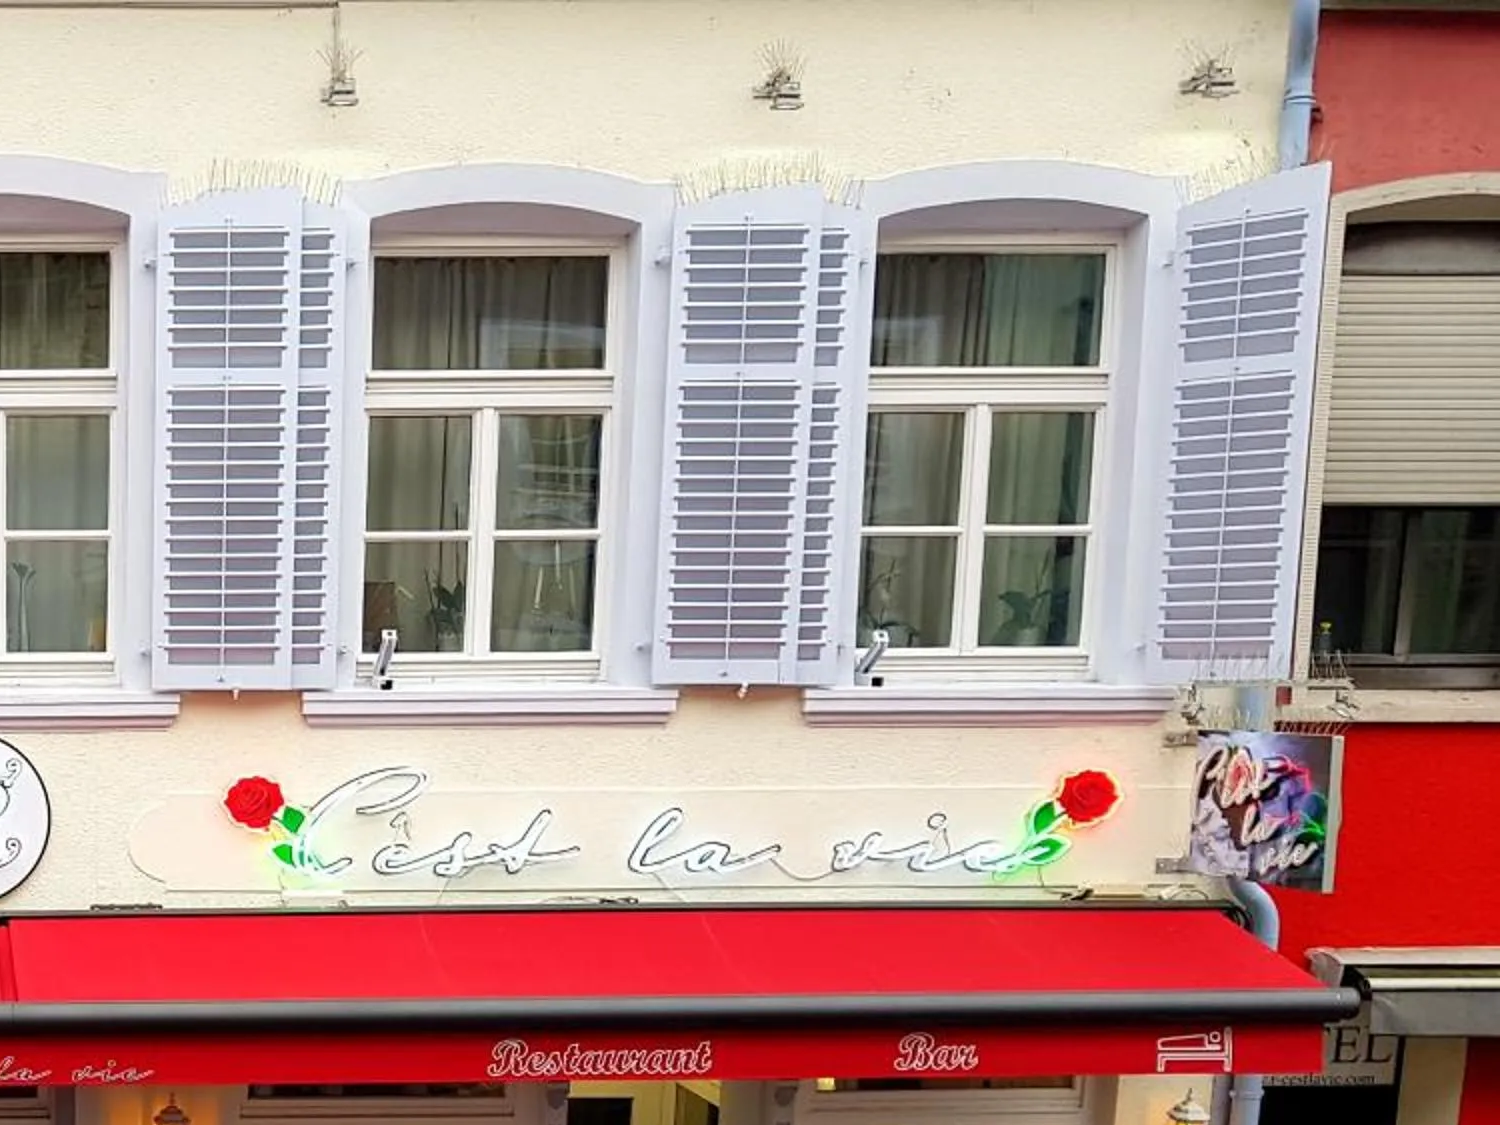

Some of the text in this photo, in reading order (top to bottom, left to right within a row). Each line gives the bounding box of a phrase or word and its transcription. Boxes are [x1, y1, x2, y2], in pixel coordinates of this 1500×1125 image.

[627, 806, 781, 875] la
[831, 813, 1050, 873] vie
[486, 1039, 713, 1079] Restaurant
[893, 1033, 979, 1071] Bar
[1322, 1026, 1393, 1063] EL
[71, 1059, 155, 1082] vie
